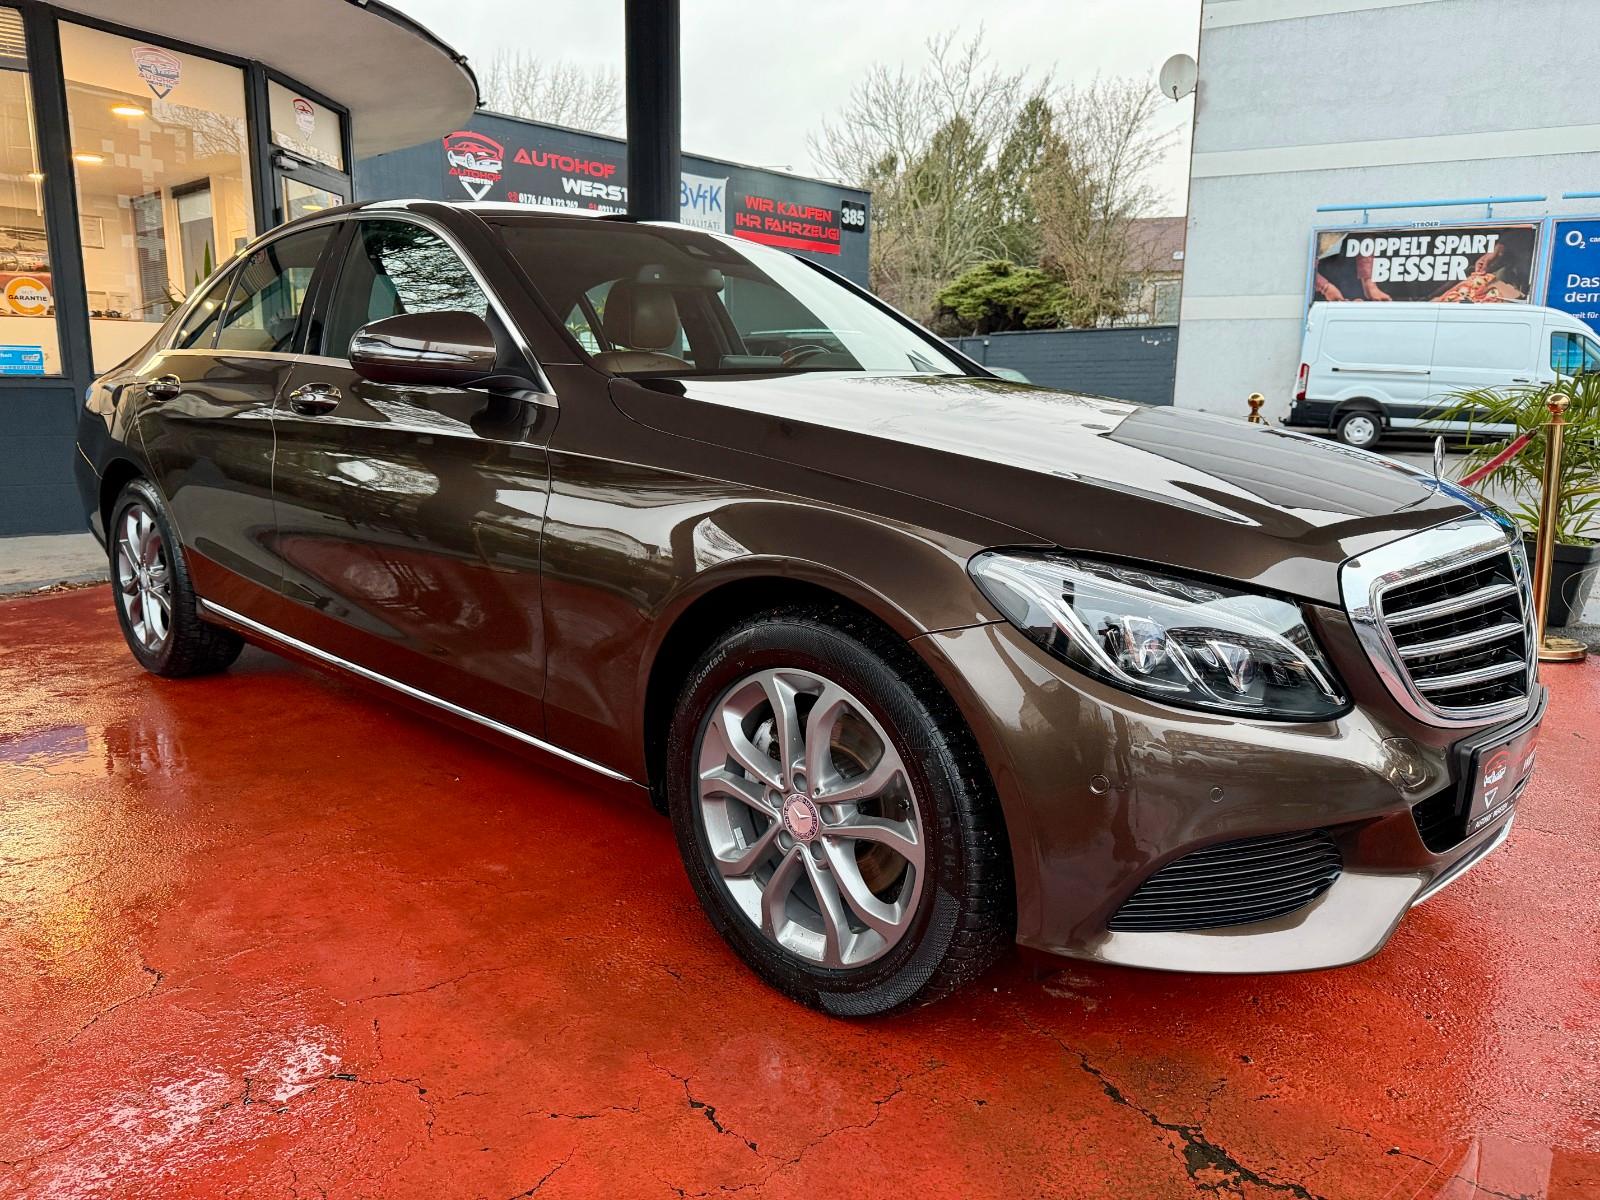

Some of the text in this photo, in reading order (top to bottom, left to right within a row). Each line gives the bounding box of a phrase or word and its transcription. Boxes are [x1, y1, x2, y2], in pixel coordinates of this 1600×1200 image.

[512, 147, 617, 179] AUTOHOF
[449, 167, 502, 182] AUTOHOF
[745, 195, 832, 223] WIR KAUFEN
[841, 207, 865, 226] 385
[735, 212, 761, 229] IHR
[1345, 234, 1499, 258] DOPPELT SPART
[1371, 255, 1469, 283] BESSER
[1566, 273, 1600, 288] Das
[8, 294, 48, 302] GARANTIE
